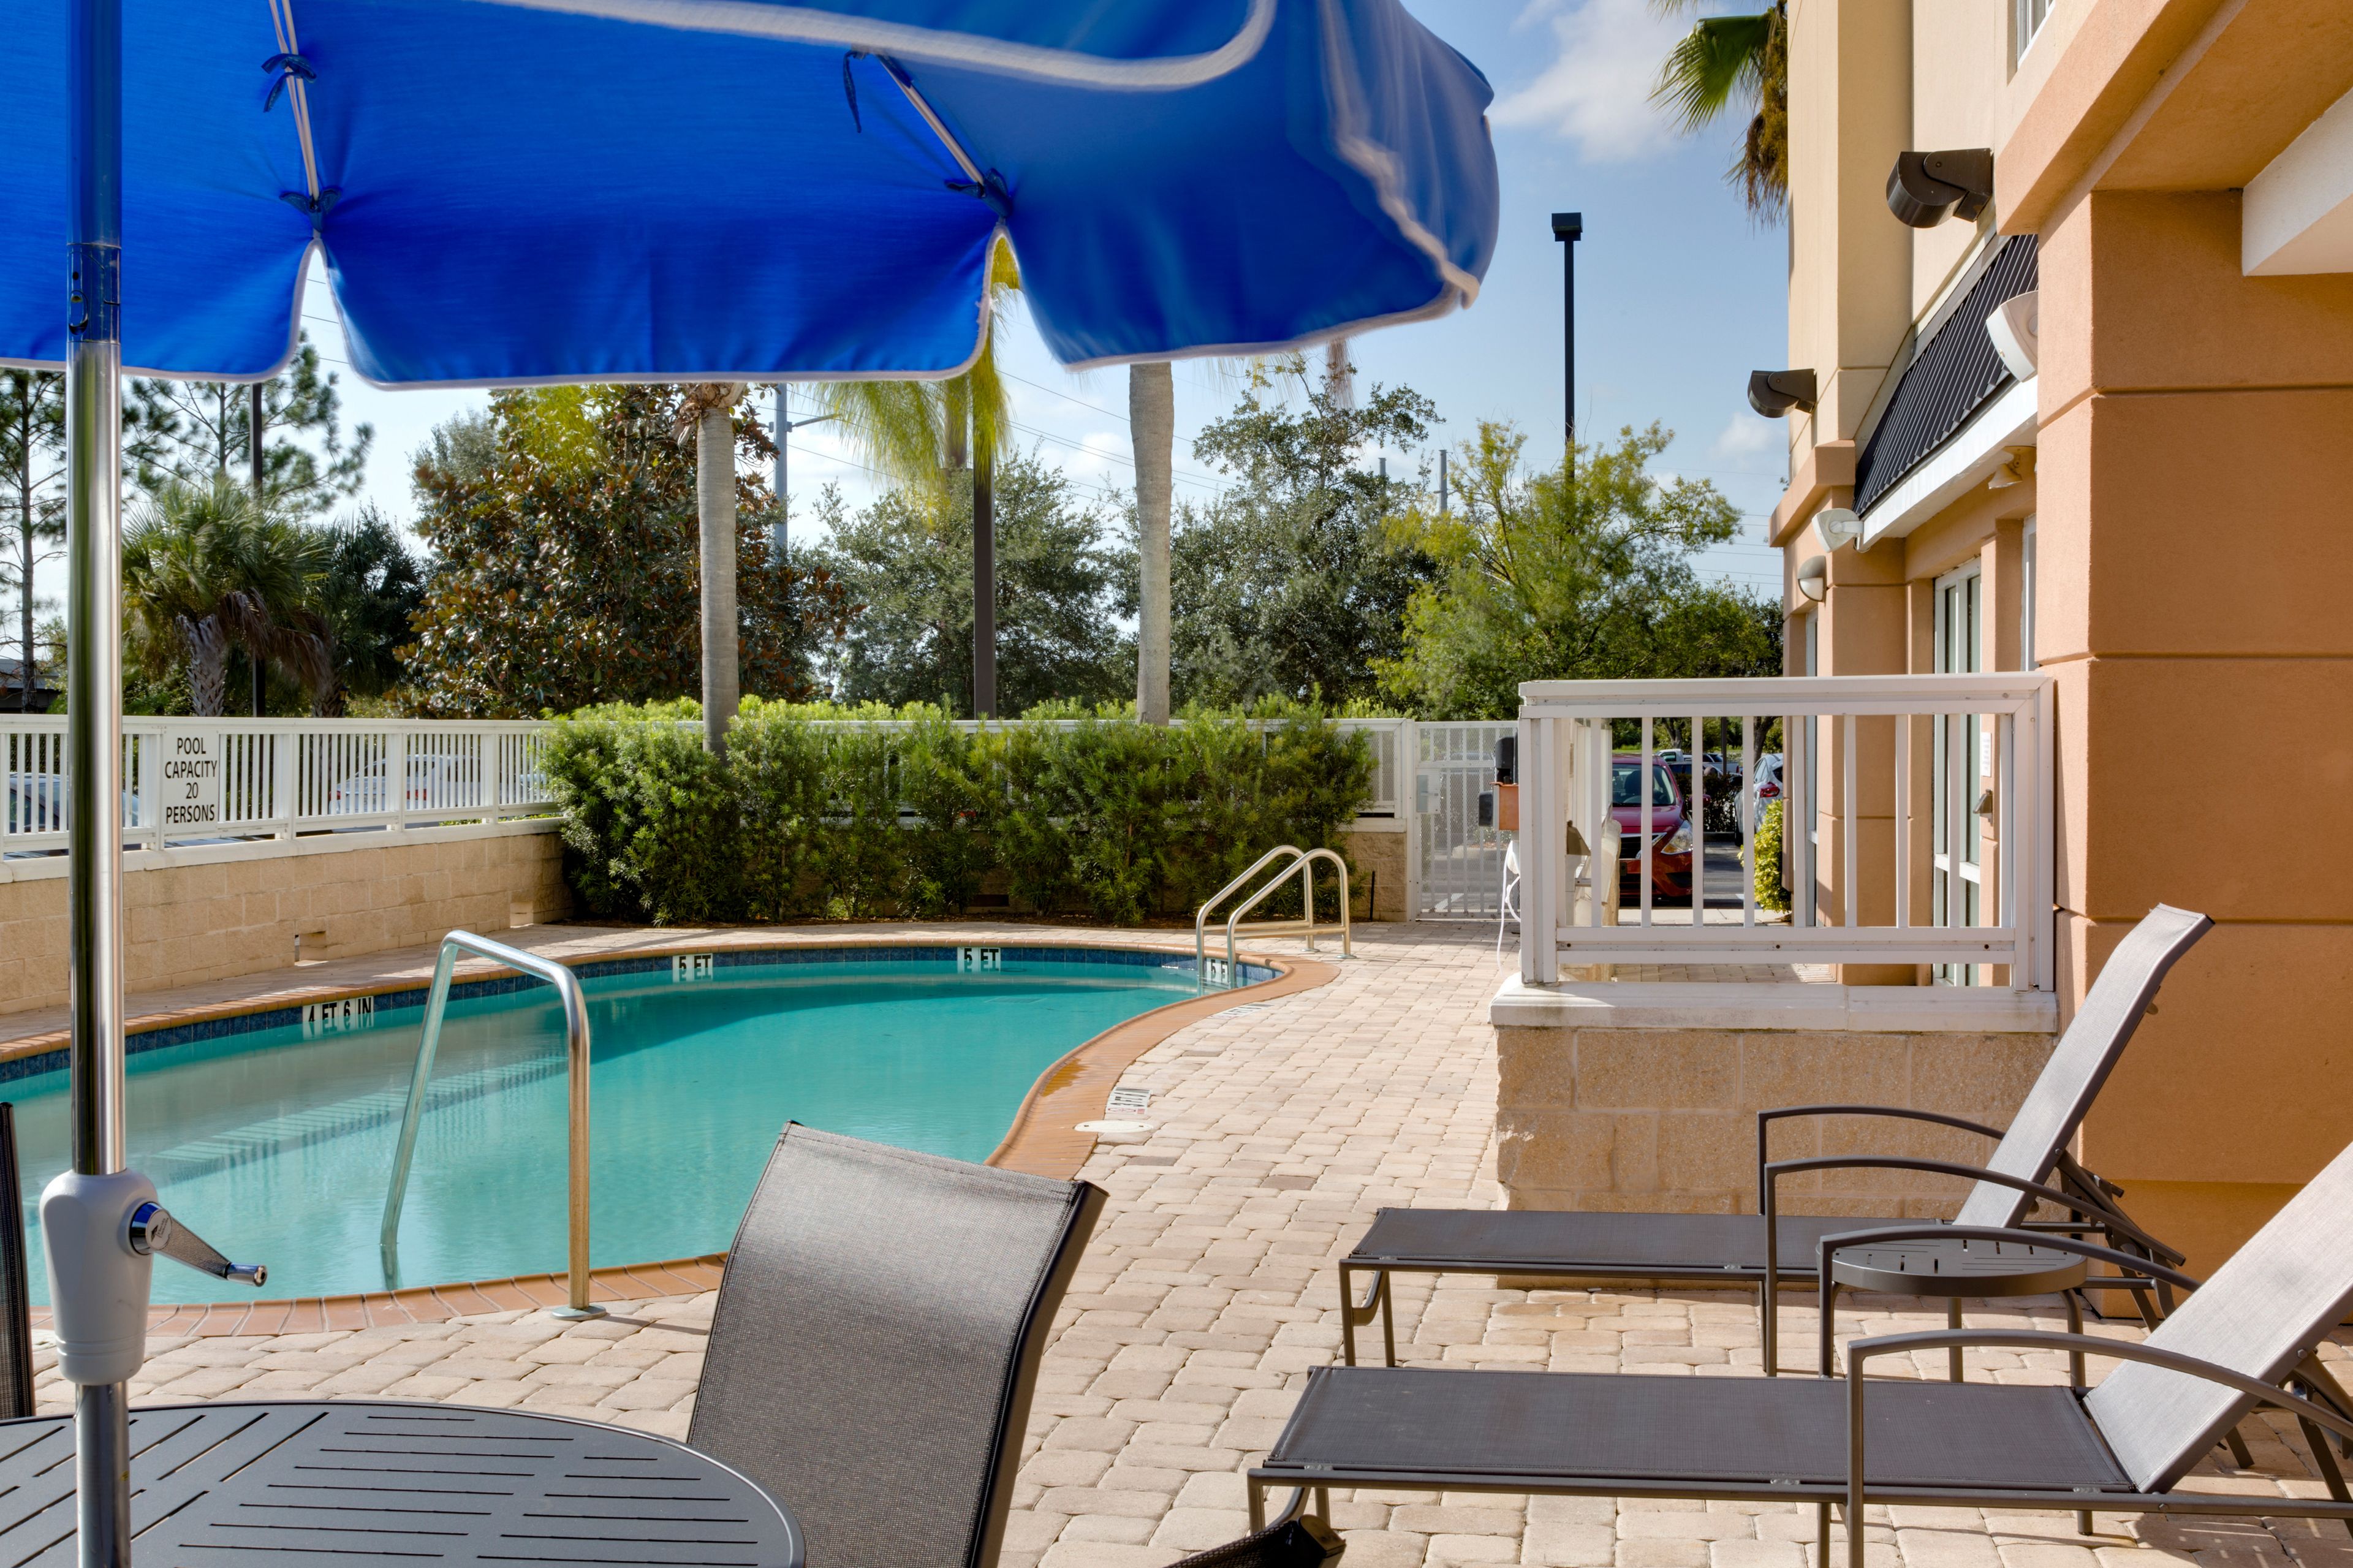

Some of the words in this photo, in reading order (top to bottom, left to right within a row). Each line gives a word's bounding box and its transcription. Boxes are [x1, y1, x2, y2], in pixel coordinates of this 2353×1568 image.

[177, 737, 207, 755] POOL
[165, 760, 218, 779] CAPACITY
[186, 782, 199, 799] 20
[166, 804, 214, 824] PERSONS
[679, 956, 686, 969] 5
[694, 955, 711, 969] FT
[964, 948, 972, 961] 5
[980, 949, 999, 961] FT
[1211, 959, 1216, 974] 5
[1221, 960, 1229, 974] F
[308, 1006, 315, 1022] 4
[322, 1002, 337, 1020] FT
[344, 1000, 350, 1017] 6
[358, 997, 371, 1015] IN
